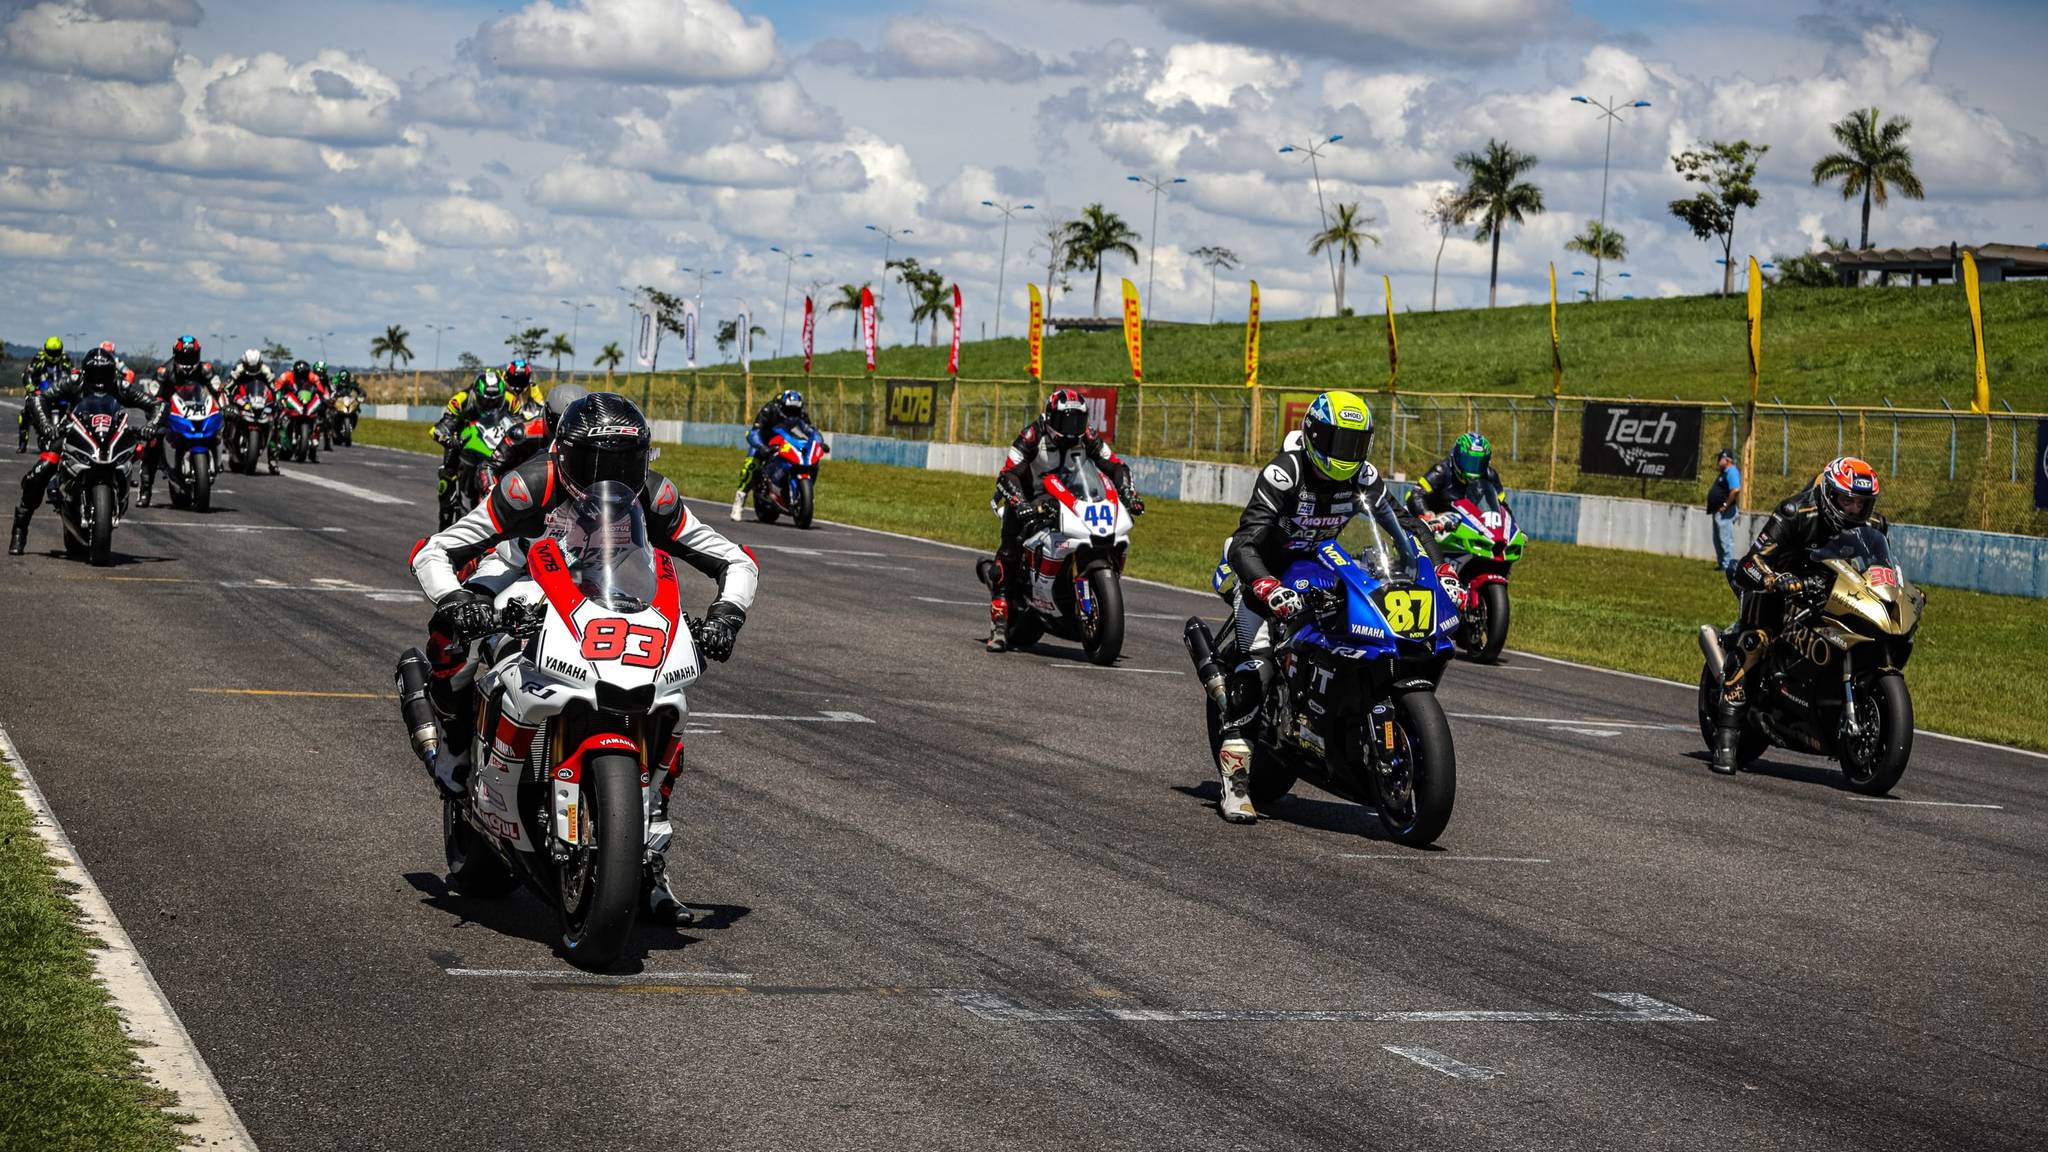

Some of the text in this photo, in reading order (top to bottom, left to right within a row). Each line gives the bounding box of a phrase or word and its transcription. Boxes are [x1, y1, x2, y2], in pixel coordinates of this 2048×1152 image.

[1086, 398, 1107, 432] UL
[1343, 411, 1362, 420] SHOEI
[1605, 408, 1677, 444] Tech
[1636, 459, 1665, 475] Time
[1084, 505, 1113, 526] 44
[1301, 517, 1340, 526] MOTUL
[1384, 590, 1433, 632] 87
[1351, 624, 1385, 639] YAMAHA
[1439, 615, 1459, 631] YAMAHA
[580, 617, 667, 669] 83
[545, 656, 588, 682] YAMAHA
[663, 665, 696, 684] YAMAHA
[599, 738, 637, 750] YAMAHA
